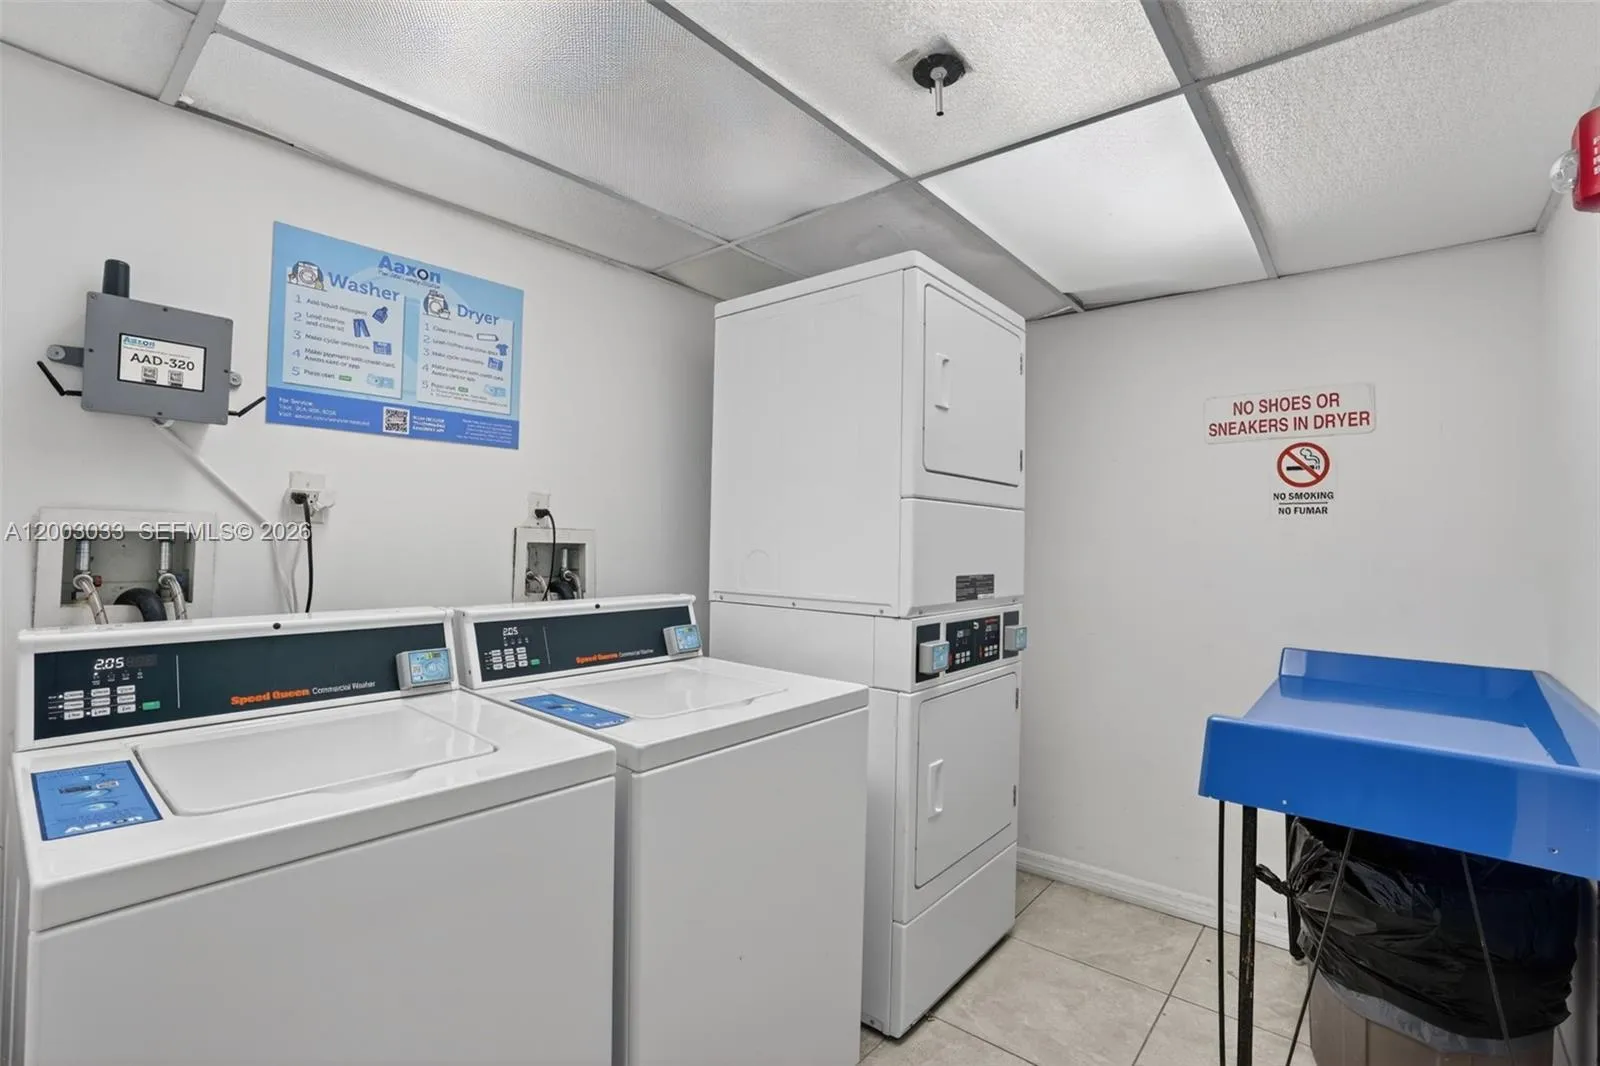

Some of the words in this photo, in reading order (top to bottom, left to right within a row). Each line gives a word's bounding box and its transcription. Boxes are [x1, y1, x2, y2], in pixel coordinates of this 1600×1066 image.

[378, 255, 441, 283] Aaxon
[328, 272, 400, 301] Washer
[296, 293, 300, 302] 1
[293, 311, 301, 321] 2
[456, 303, 500, 325] Dryer
[424, 322, 428, 330] 1
[293, 329, 301, 340] 3
[423, 334, 430, 343] 2
[292, 348, 300, 358] 4
[423, 347, 429, 356] 3
[130, 353, 195, 371] AAD-320
[291, 365, 300, 376] 5
[1233, 401, 1254, 416] NO
[1259, 395, 1311, 414] SHOES
[1316, 392, 1340, 408] OR
[1208, 417, 1289, 437] SNEAKERS
[1293, 416, 1308, 431] IN
[1313, 411, 1370, 430] DRYER
[1273, 492, 1286, 501] NO
[1288, 491, 1334, 501] SMOKING
[1278, 507, 1291, 515] NO
[1294, 506, 1328, 515] FUMAR
[93, 656, 125, 670] 2.05
[575, 654, 597, 664] Speed
[597, 652, 618, 661] Queen
[230, 691, 271, 706] Speed
[272, 688, 311, 700] Queen
[312, 684, 351, 695] Commercial
[352, 681, 376, 690] Washer
